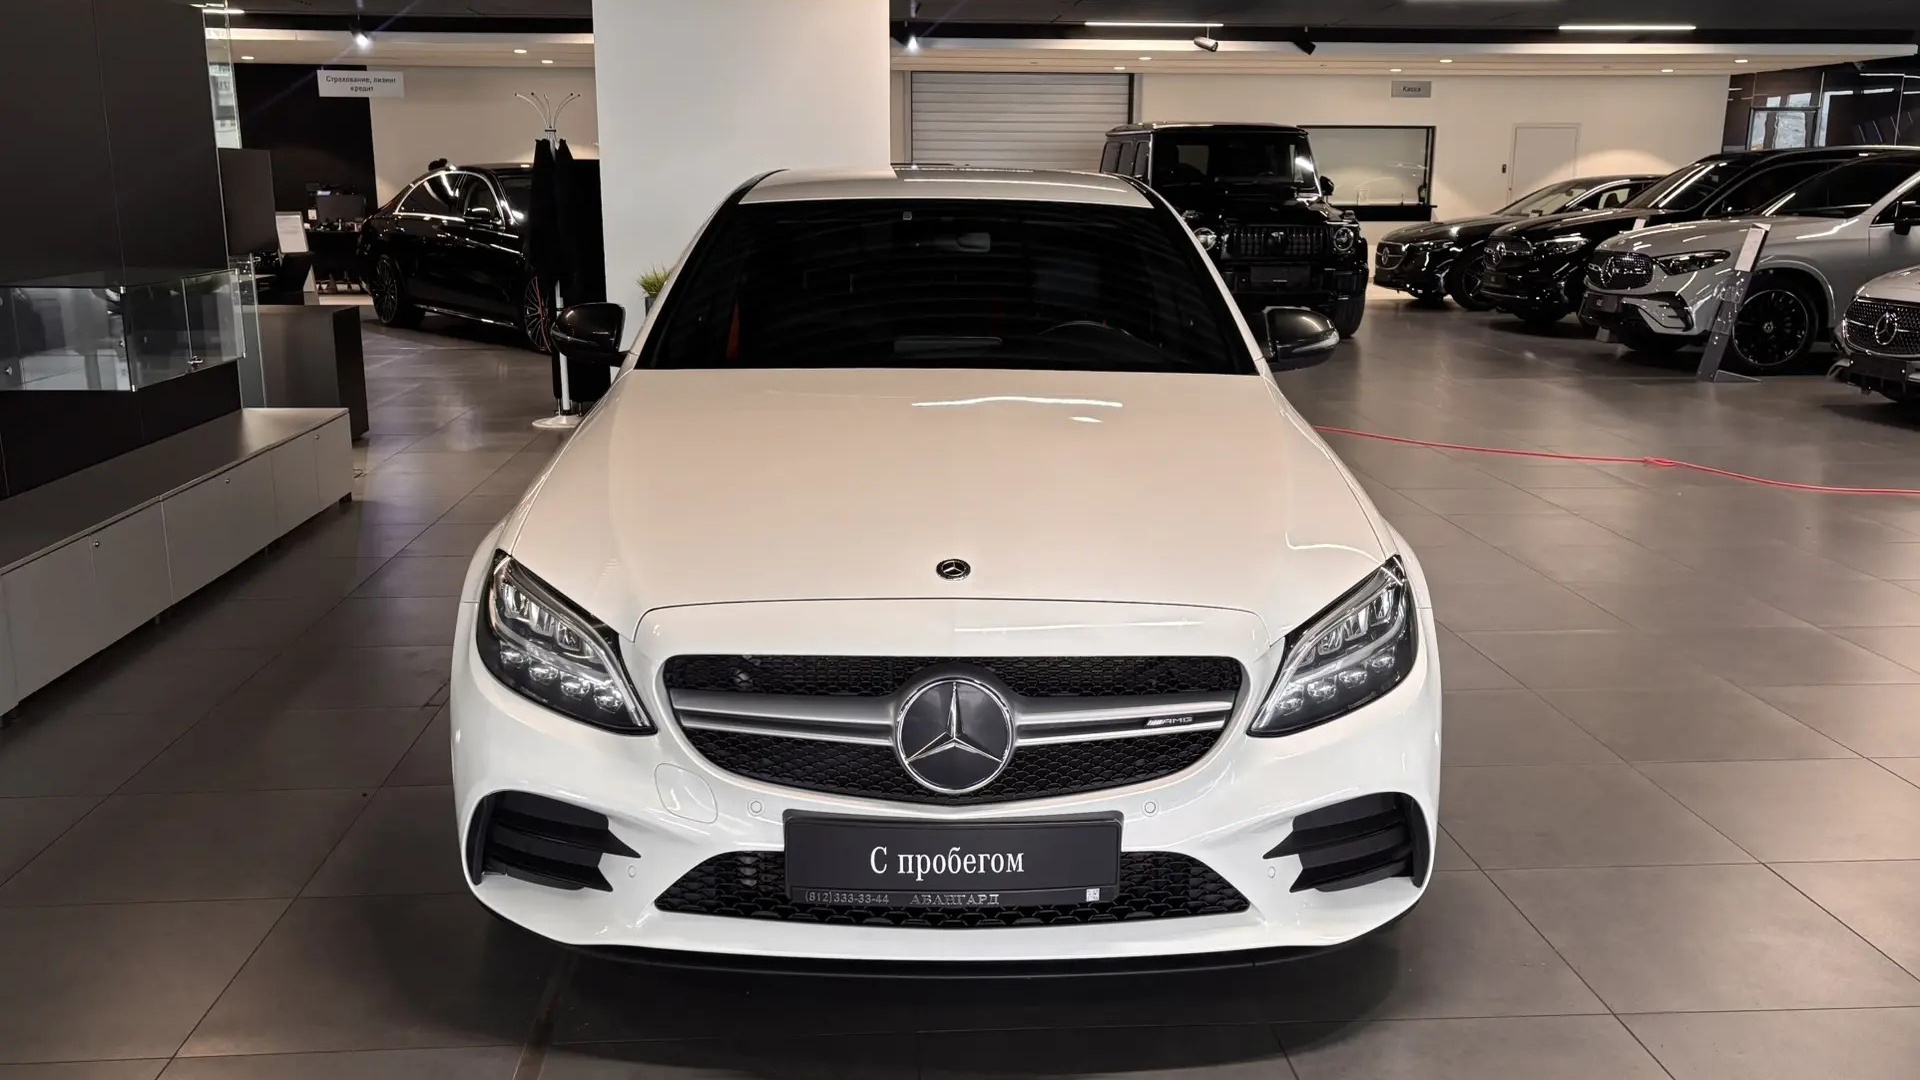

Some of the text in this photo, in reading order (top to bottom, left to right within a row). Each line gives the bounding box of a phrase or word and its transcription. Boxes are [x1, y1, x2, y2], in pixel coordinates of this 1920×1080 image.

[870, 846, 1024, 881] С пробегом
[805, 890, 999, 905] (812)333-33-44 АВАНГАРД
